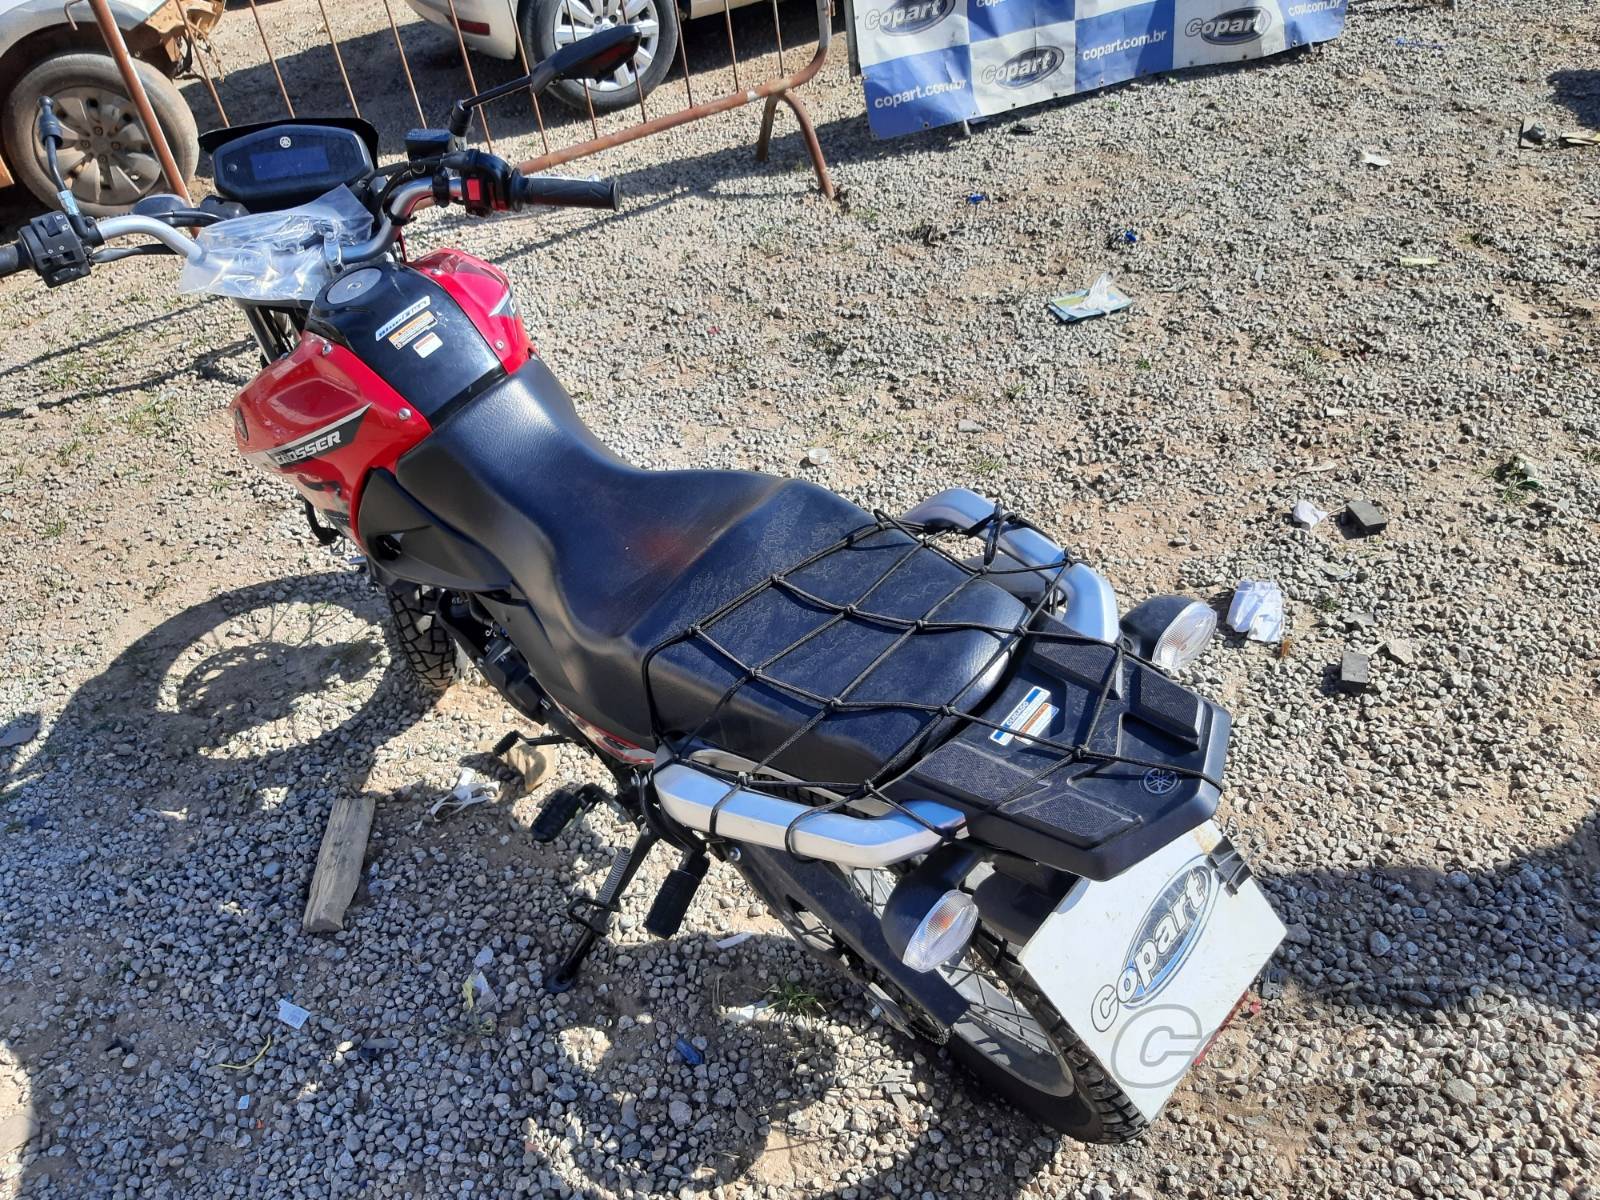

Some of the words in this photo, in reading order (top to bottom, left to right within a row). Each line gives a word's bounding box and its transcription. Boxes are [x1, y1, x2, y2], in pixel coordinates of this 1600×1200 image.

[864, 0, 941, 30] Copart
[1184, 17, 1258, 38] Copar
[1082, 29, 1167, 60] copart.com.br
[981, 49, 1053, 85] Copart
[1090, 868, 1205, 1033] Copart
